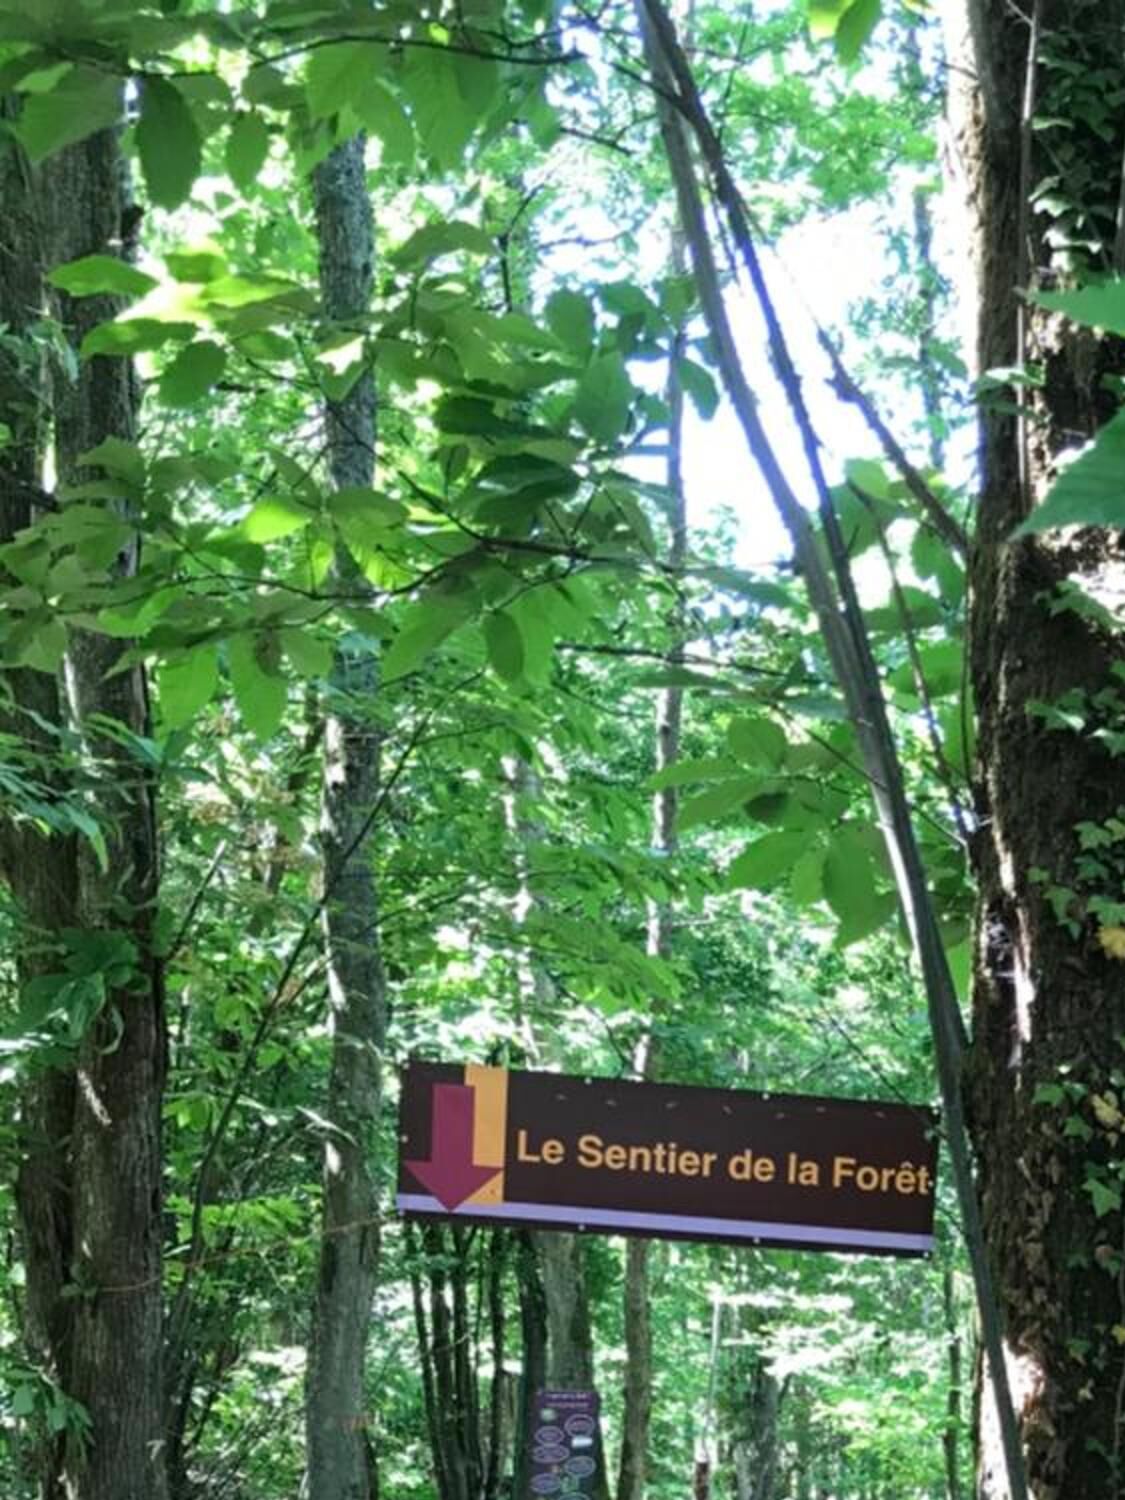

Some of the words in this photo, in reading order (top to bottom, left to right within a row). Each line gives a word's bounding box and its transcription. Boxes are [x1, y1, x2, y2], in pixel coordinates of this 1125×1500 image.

[516, 1129, 565, 1165] Le
[576, 1134, 718, 1178] Sentier
[728, 1149, 776, 1183] de
[788, 1153, 820, 1186] la
[832, 1157, 931, 1195] Forêt
